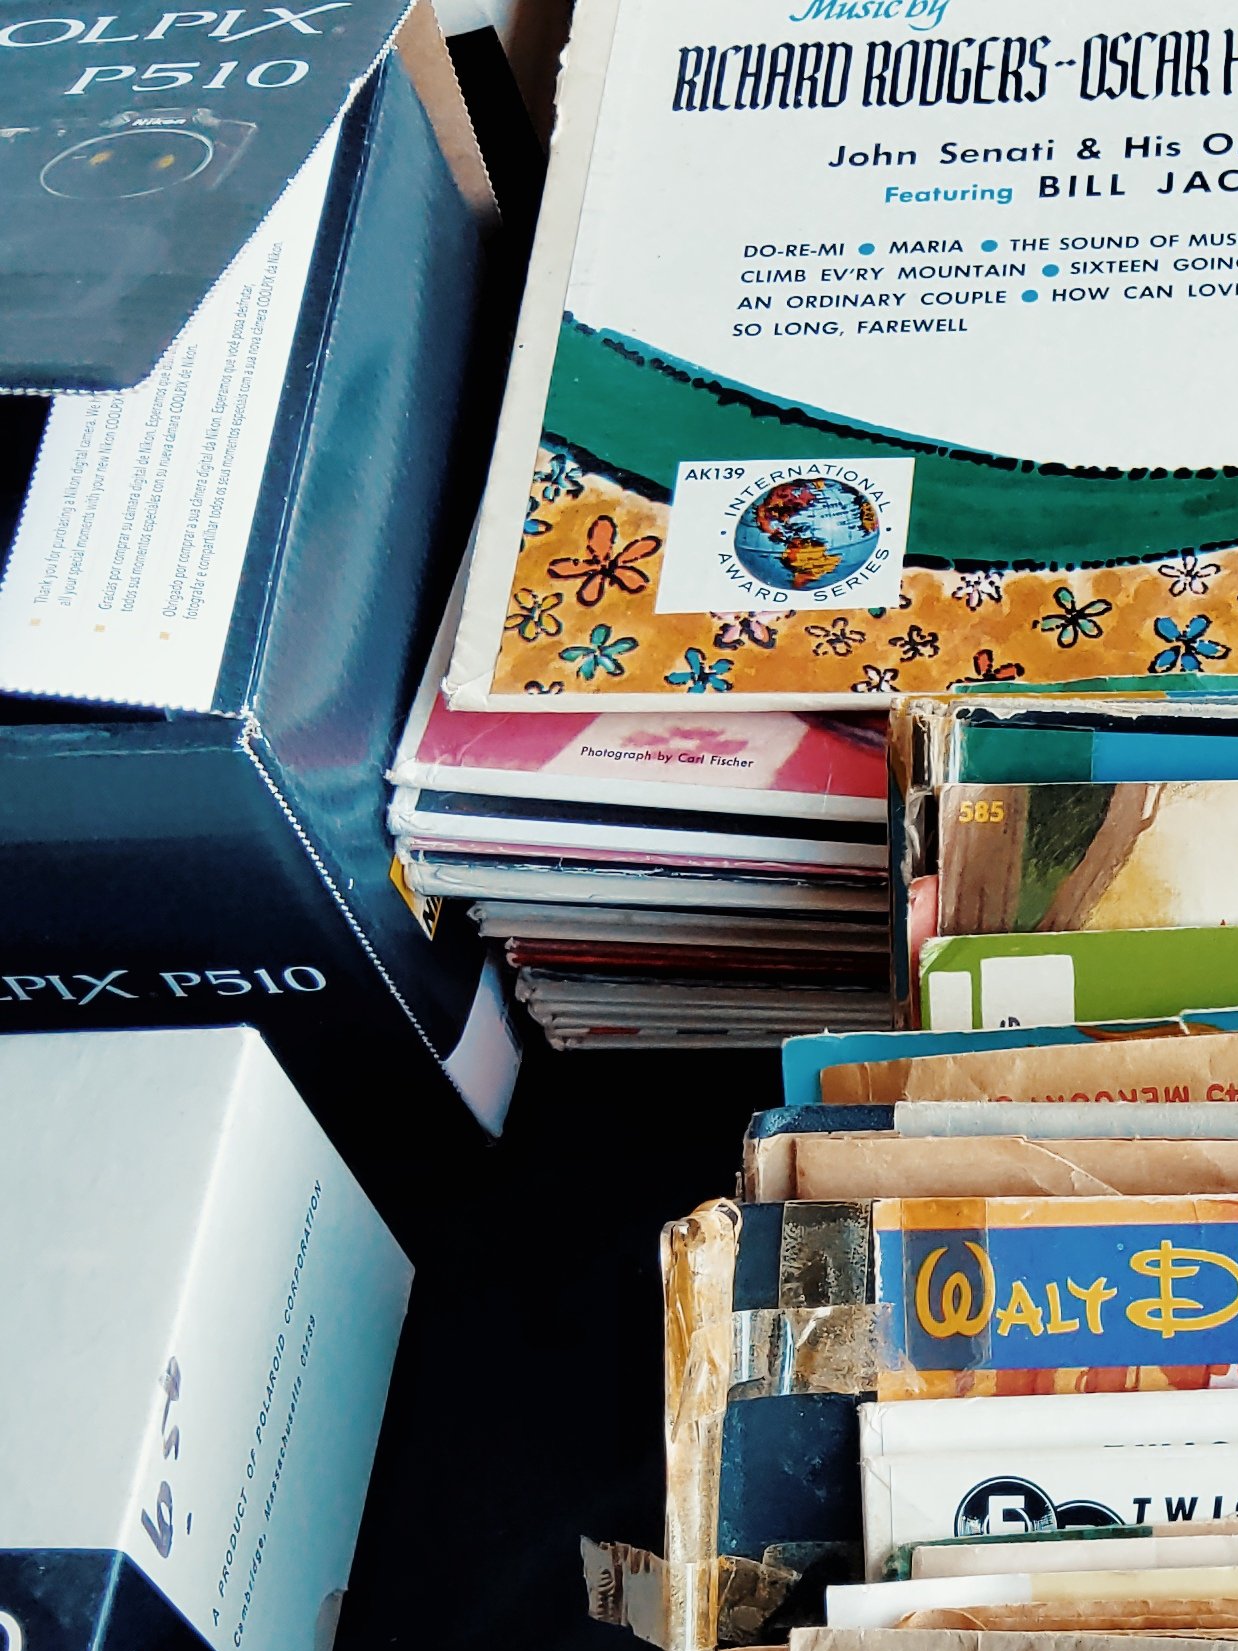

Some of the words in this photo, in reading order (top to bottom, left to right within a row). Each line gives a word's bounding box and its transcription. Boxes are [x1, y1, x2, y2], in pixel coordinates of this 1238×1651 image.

[789, 0, 900, 22] Music
[904, 0, 949, 31] by
[64, 60, 309, 96] P510
[672, 41, 853, 112] RICHARD
[131, 116, 187, 127] Nikon
[828, 143, 916, 167] John
[940, 139, 1054, 164] Senati
[1077, 138, 1100, 160] &
[1125, 136, 1181, 158] His
[885, 184, 1012, 204] Featuring
[1039, 174, 1125, 198] BILL
[744, 243, 844, 257] DO-RE-MI
[889, 240, 963, 254] MARIA
[1010, 238, 1049, 251] THE
[1060, 236, 1139, 250] SOUND
[1150, 235, 1179, 247] OF
[741, 270, 806, 283] CLIMB
[821, 268, 884, 281] EV'RY
[898, 264, 1025, 279] MOUNTAIN
[1071, 259, 1158, 274] SIXTEEN
[737, 296, 771, 309] AN
[787, 293, 906, 308] ORDINARY
[921, 291, 1006, 305] COUPLE
[1053, 287, 1109, 302] HOW
[1124, 285, 1172, 299] CAN
[733, 323, 762, 336] SO
[774, 322, 844, 336] LONG,
[858, 319, 967, 334] FAREWELL
[685, 467, 745, 480] AK139
[724, 463, 892, 518] INTERNATIONAL
[34, 577, 50, 604] Thank
[64, 473, 80, 499] Nikon
[77, 510, 94, 548] moments
[718, 552, 789, 604] AWARD
[813, 548, 891, 603] SERIES
[580, 746, 651, 761] Photograph
[657, 751, 672, 764] by
[678, 752, 704, 765] Carl
[710, 755, 754, 768] Fischer
[959, 800, 1004, 823] 585
[0, 969, 140, 1006] PIX
[159, 966, 327, 997] P510
[212, 1608, 220, 1626] A
[218, 1487, 248, 1598] PRODUCT
[246, 1448, 256, 1479] OF
[255, 1334, 286, 1445] POLAROID
[284, 1180, 322, 1324] CORPORATION
[233, 1533, 267, 1648] Cambridge,
